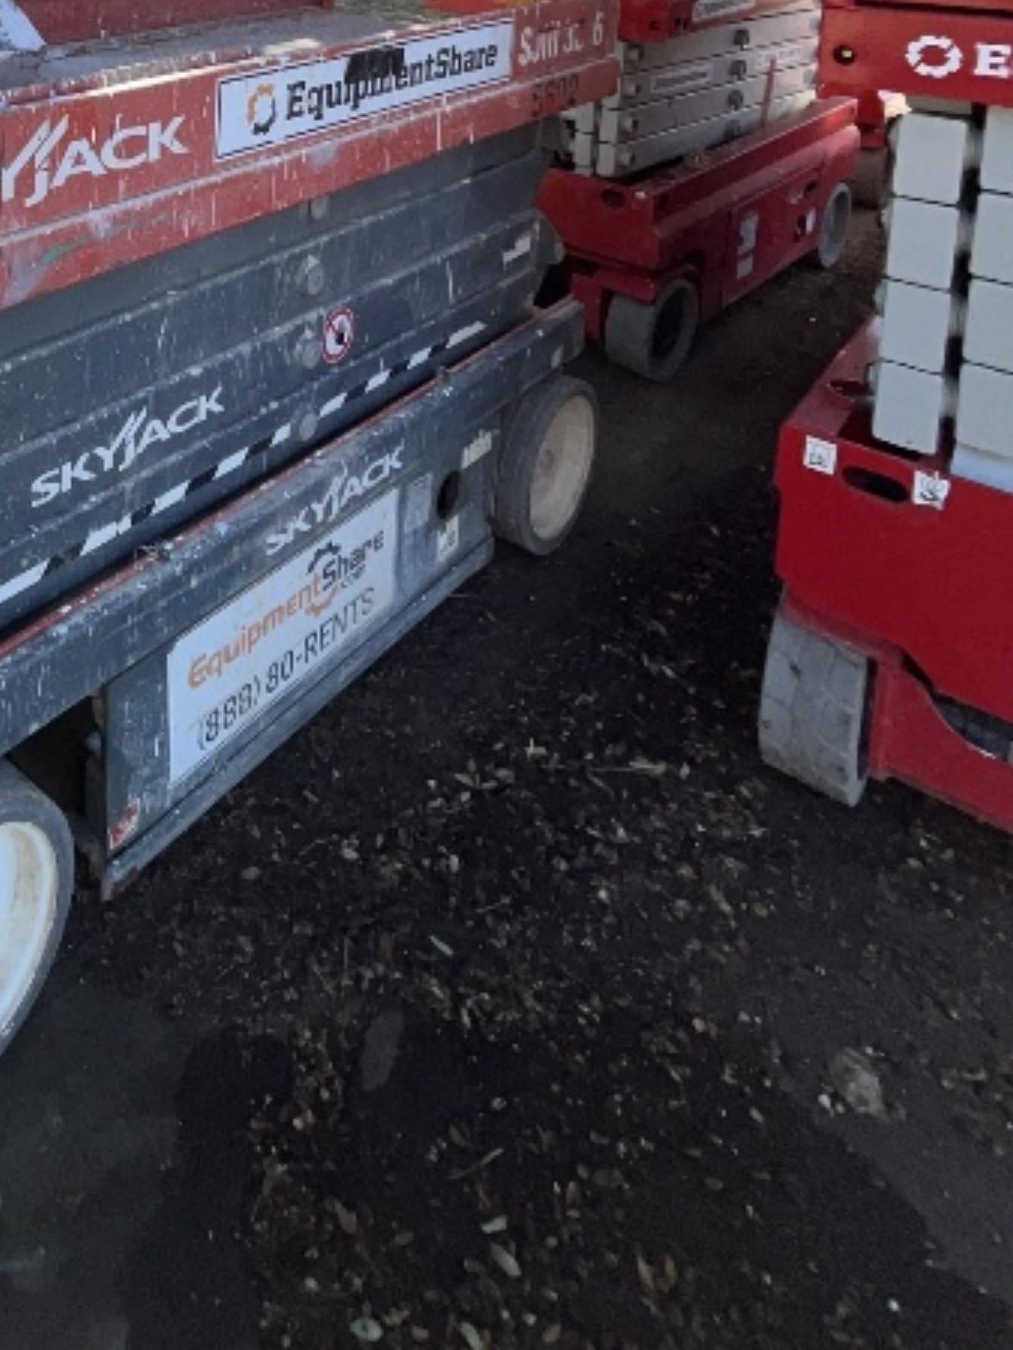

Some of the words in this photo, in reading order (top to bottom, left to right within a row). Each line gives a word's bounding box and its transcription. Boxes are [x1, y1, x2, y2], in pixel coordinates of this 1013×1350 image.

[30, 381, 225, 508] SKYJACK
[266, 438, 405, 556] SKYJACK
[197, 676, 261, 750] (888)
[265, 587, 376, 694] 80-RENTS
